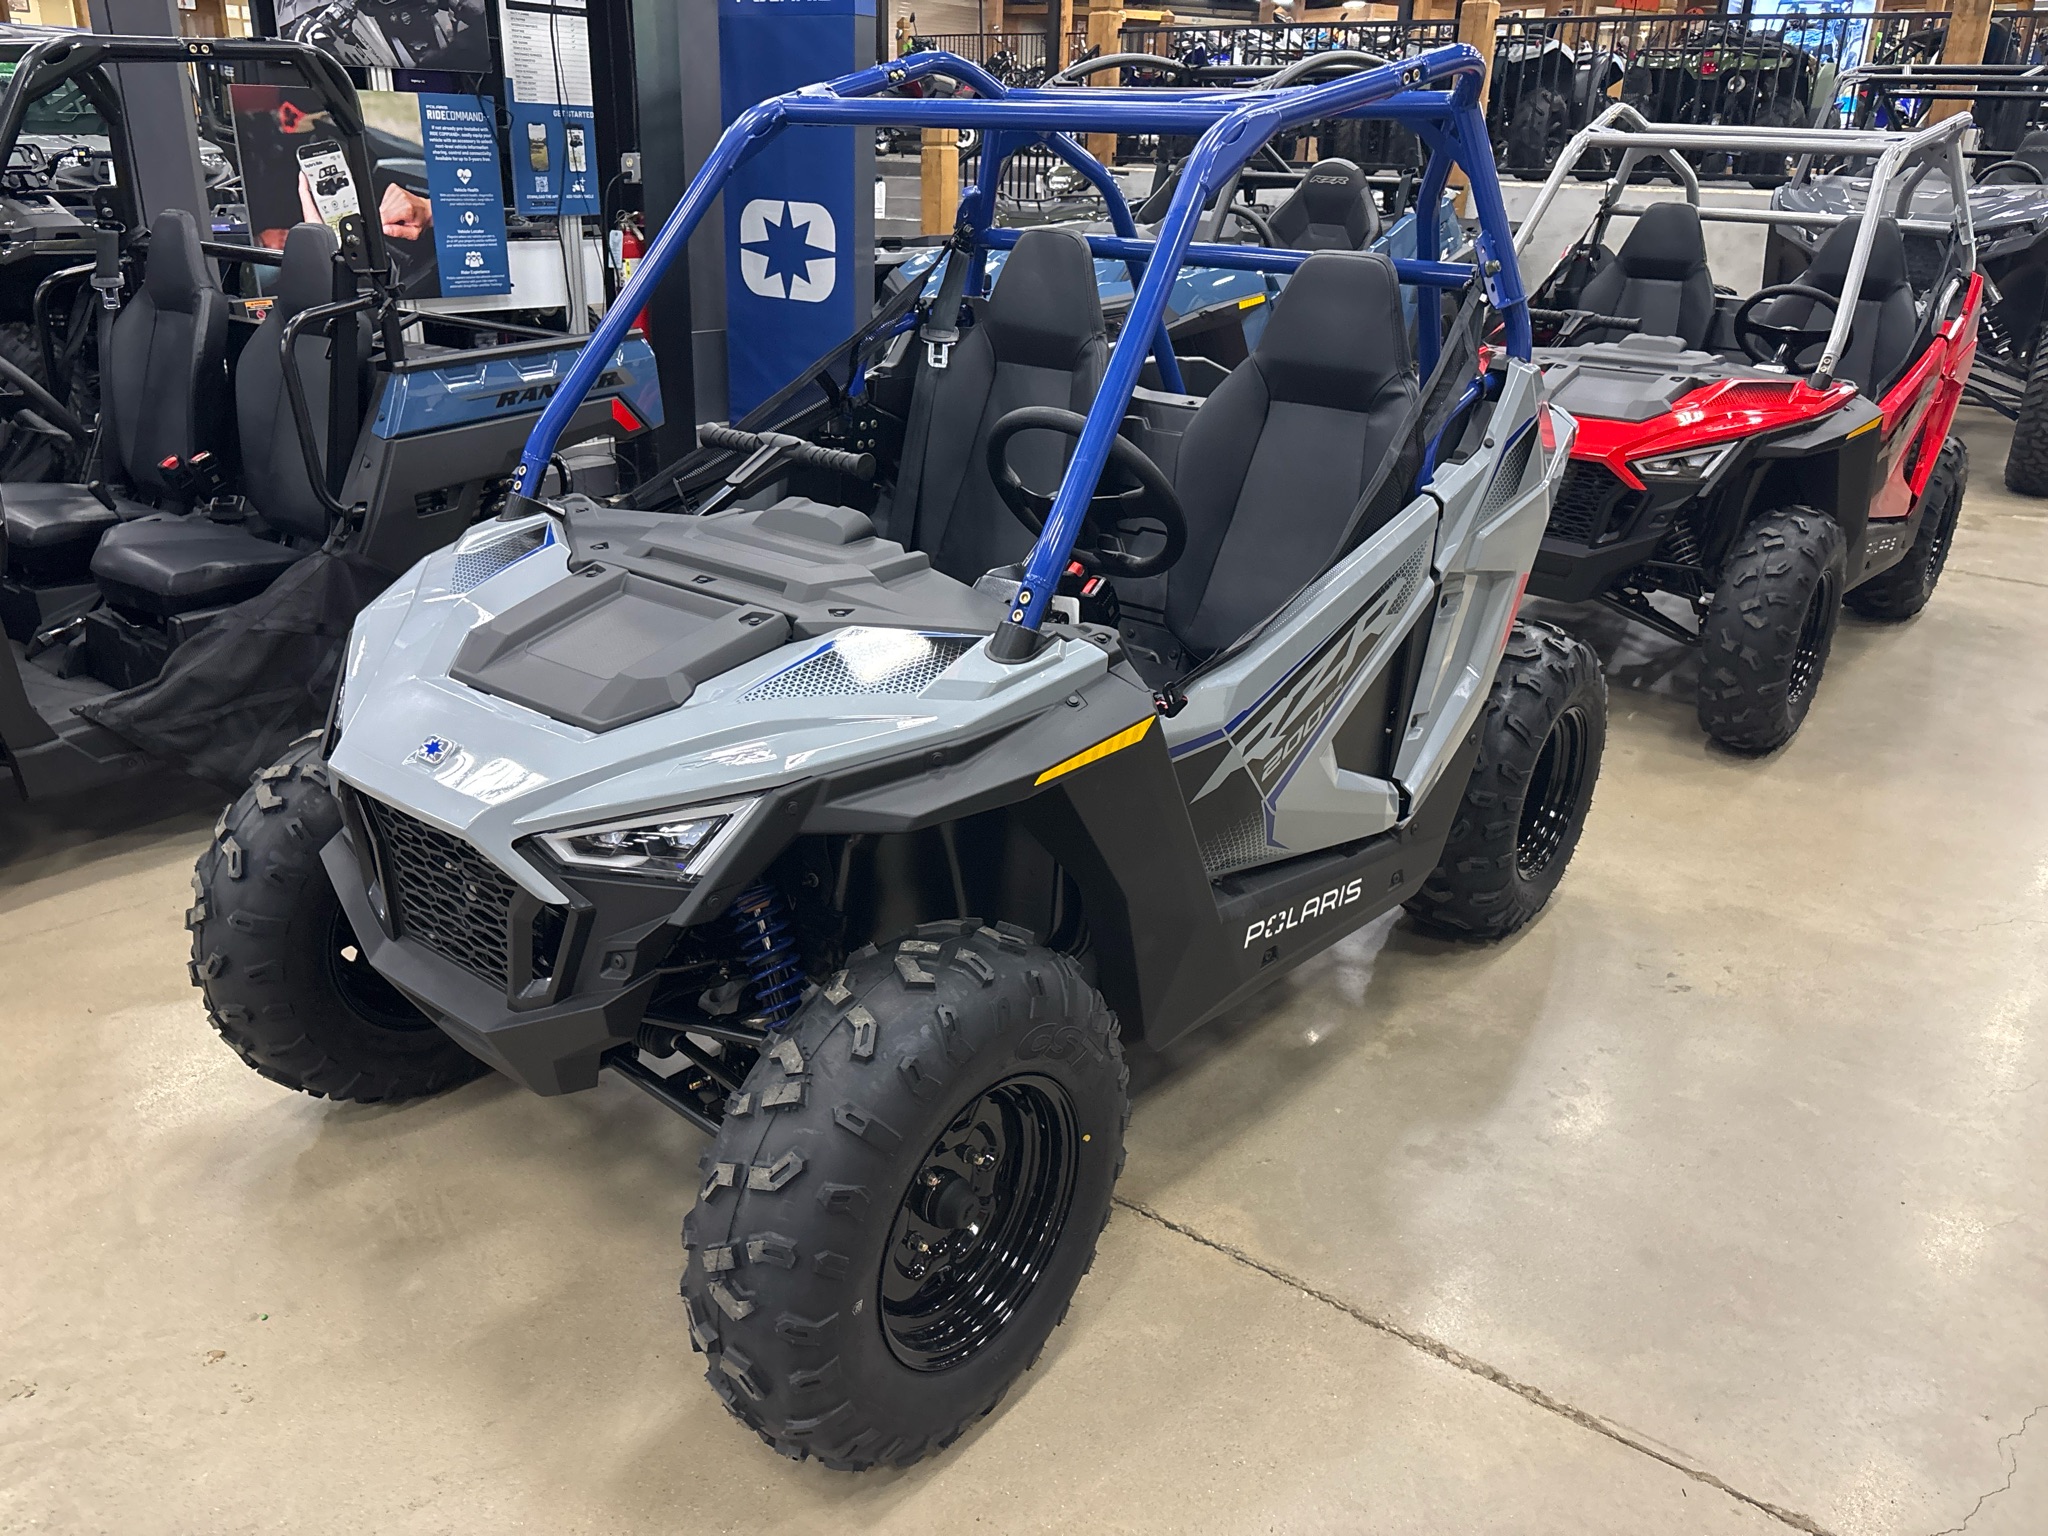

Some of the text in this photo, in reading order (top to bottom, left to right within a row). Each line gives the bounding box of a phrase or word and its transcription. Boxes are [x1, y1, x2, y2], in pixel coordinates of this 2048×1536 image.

[1309, 174, 1350, 185] RZR
[495, 371, 625, 408] RANR
[1261, 702, 1325, 782] 200
[1243, 877, 1362, 949] POLARIS
